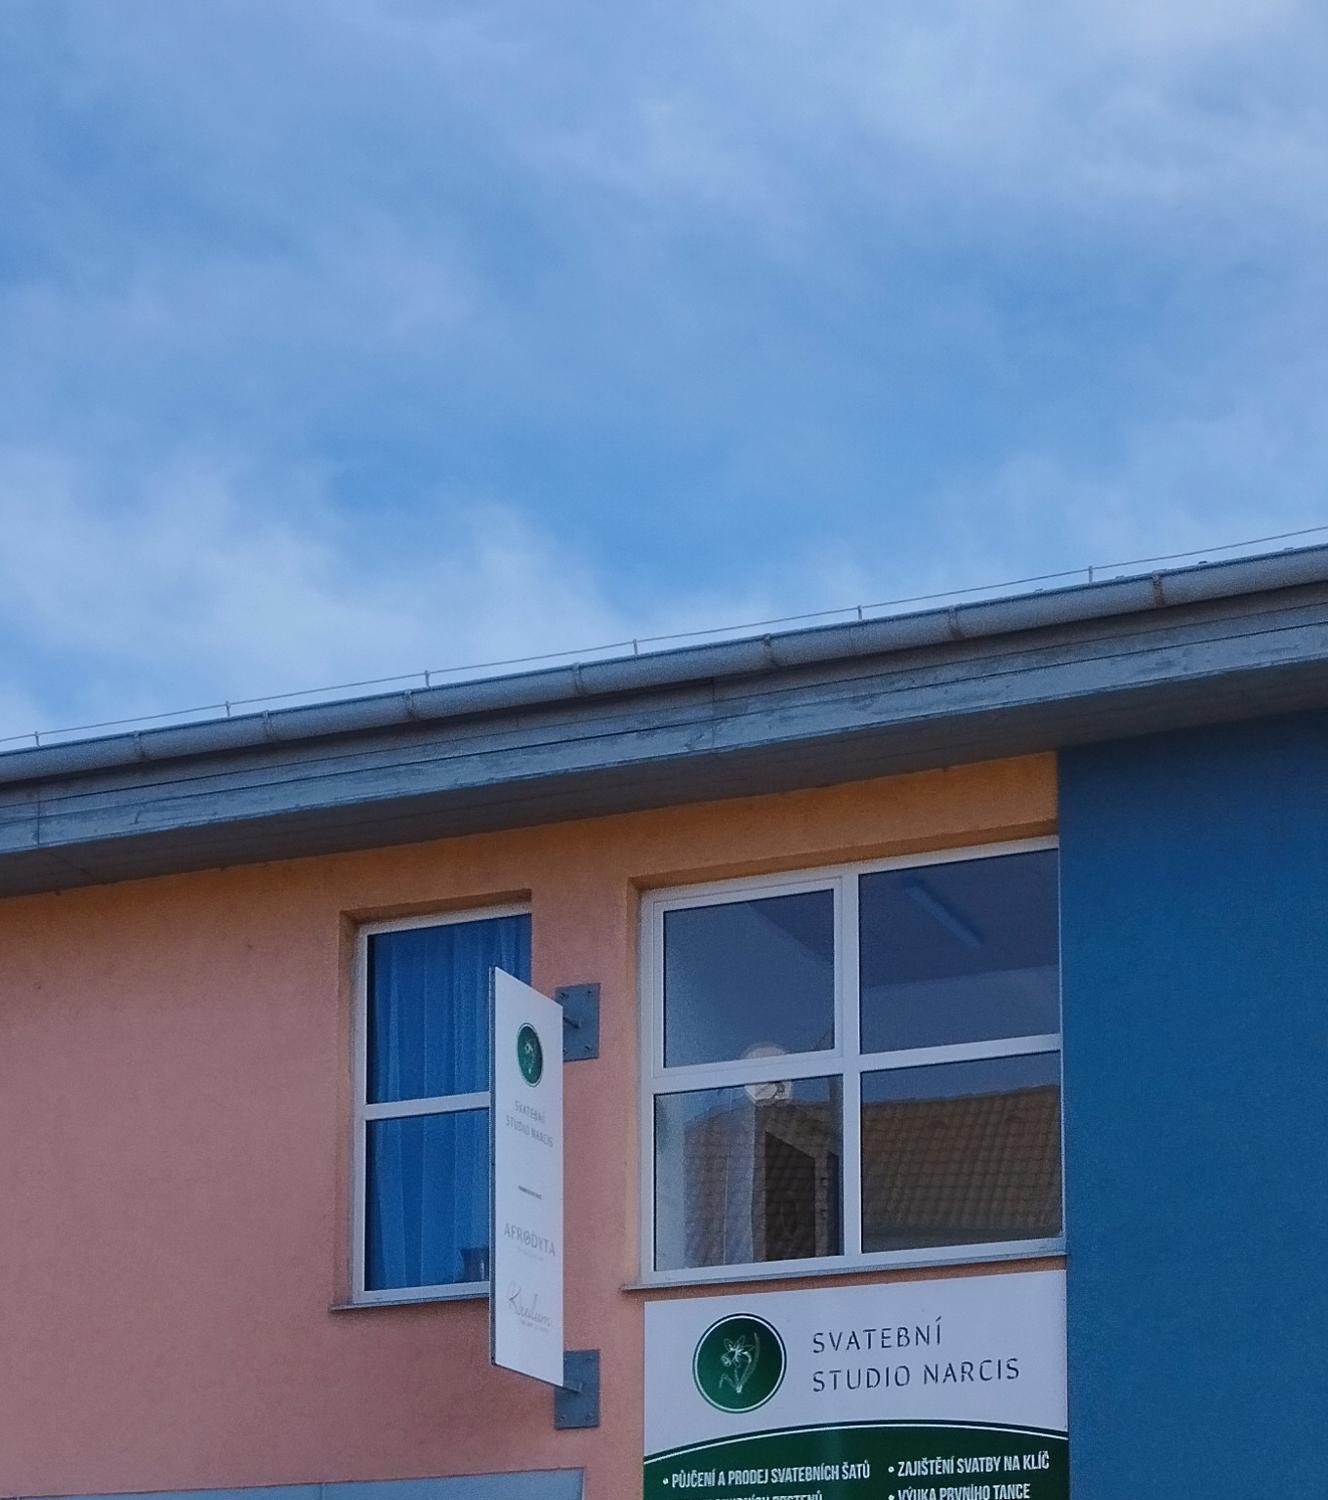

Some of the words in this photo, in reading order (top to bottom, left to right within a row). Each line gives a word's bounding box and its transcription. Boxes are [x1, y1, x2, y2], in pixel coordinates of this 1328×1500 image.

[813, 1316, 942, 1353] SVATEBNÍ
[813, 1365, 911, 1392] STUDIO
[923, 1358, 1020, 1384] NARCIS
[672, 1468, 716, 1488] PŮJČENÍ
[718, 1472, 726, 1486] A
[728, 1469, 769, 1486] PRODEJ
[771, 1463, 840, 1484] SVATEBNÍCH
[842, 1460, 870, 1480] ŠATŮ
[897, 1456, 954, 1477] ZAJIŠTĚNÍ
[956, 1456, 1001, 1474] SVATBY
[1003, 1455, 1020, 1471] NA
[1022, 1451, 1050, 1471] KLÍČ
[992, 1483, 1031, 1500] TANCE
